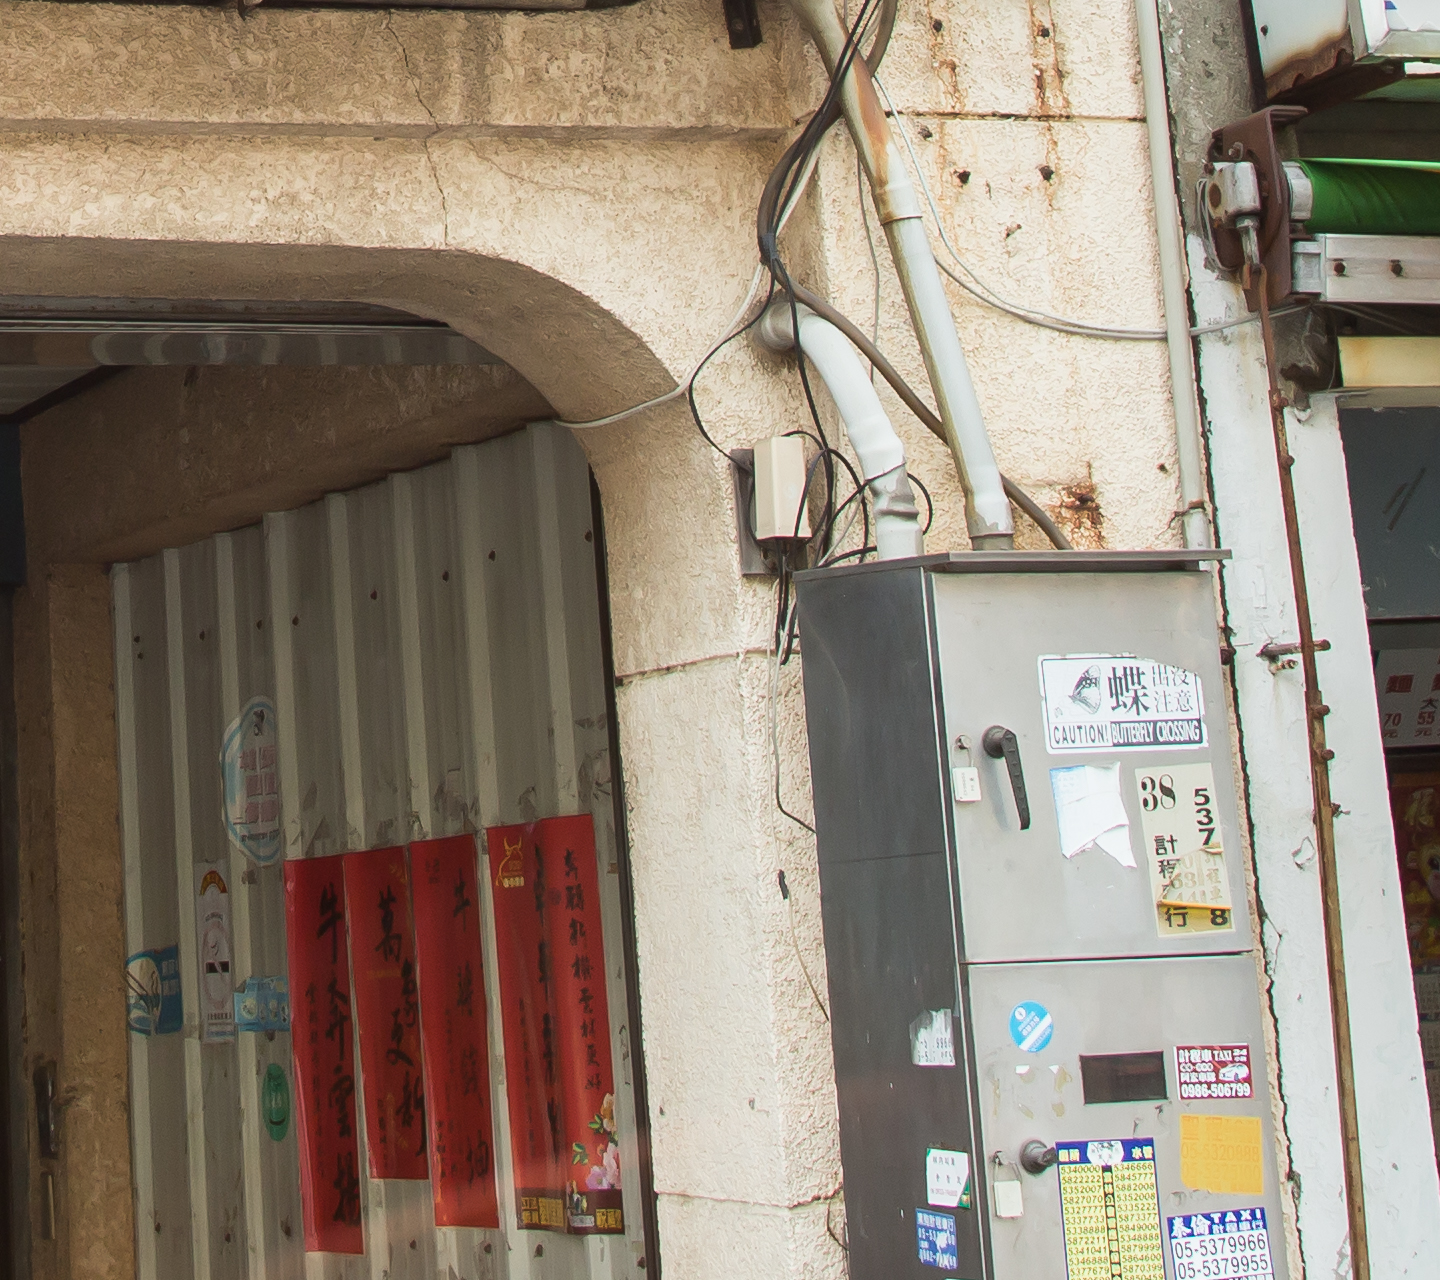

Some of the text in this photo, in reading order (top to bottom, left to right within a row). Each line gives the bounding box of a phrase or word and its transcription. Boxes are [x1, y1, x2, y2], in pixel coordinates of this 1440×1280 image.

[1107, 665, 1150, 716] 蝶
[1053, 721, 1200, 745] CAUTION! BUTTERFLY CROSSING
[1141, 774, 1176, 811] 38
[1213, 1050, 1232, 1061] TAXI
[1181, 1083, 1251, 1098] 0986-506799
[1210, 1208, 1262, 1224] TAXI
[1175, 1233, 1266, 1259] 05-5379966
[1178, 1254, 1268, 1279] 05-5379955
